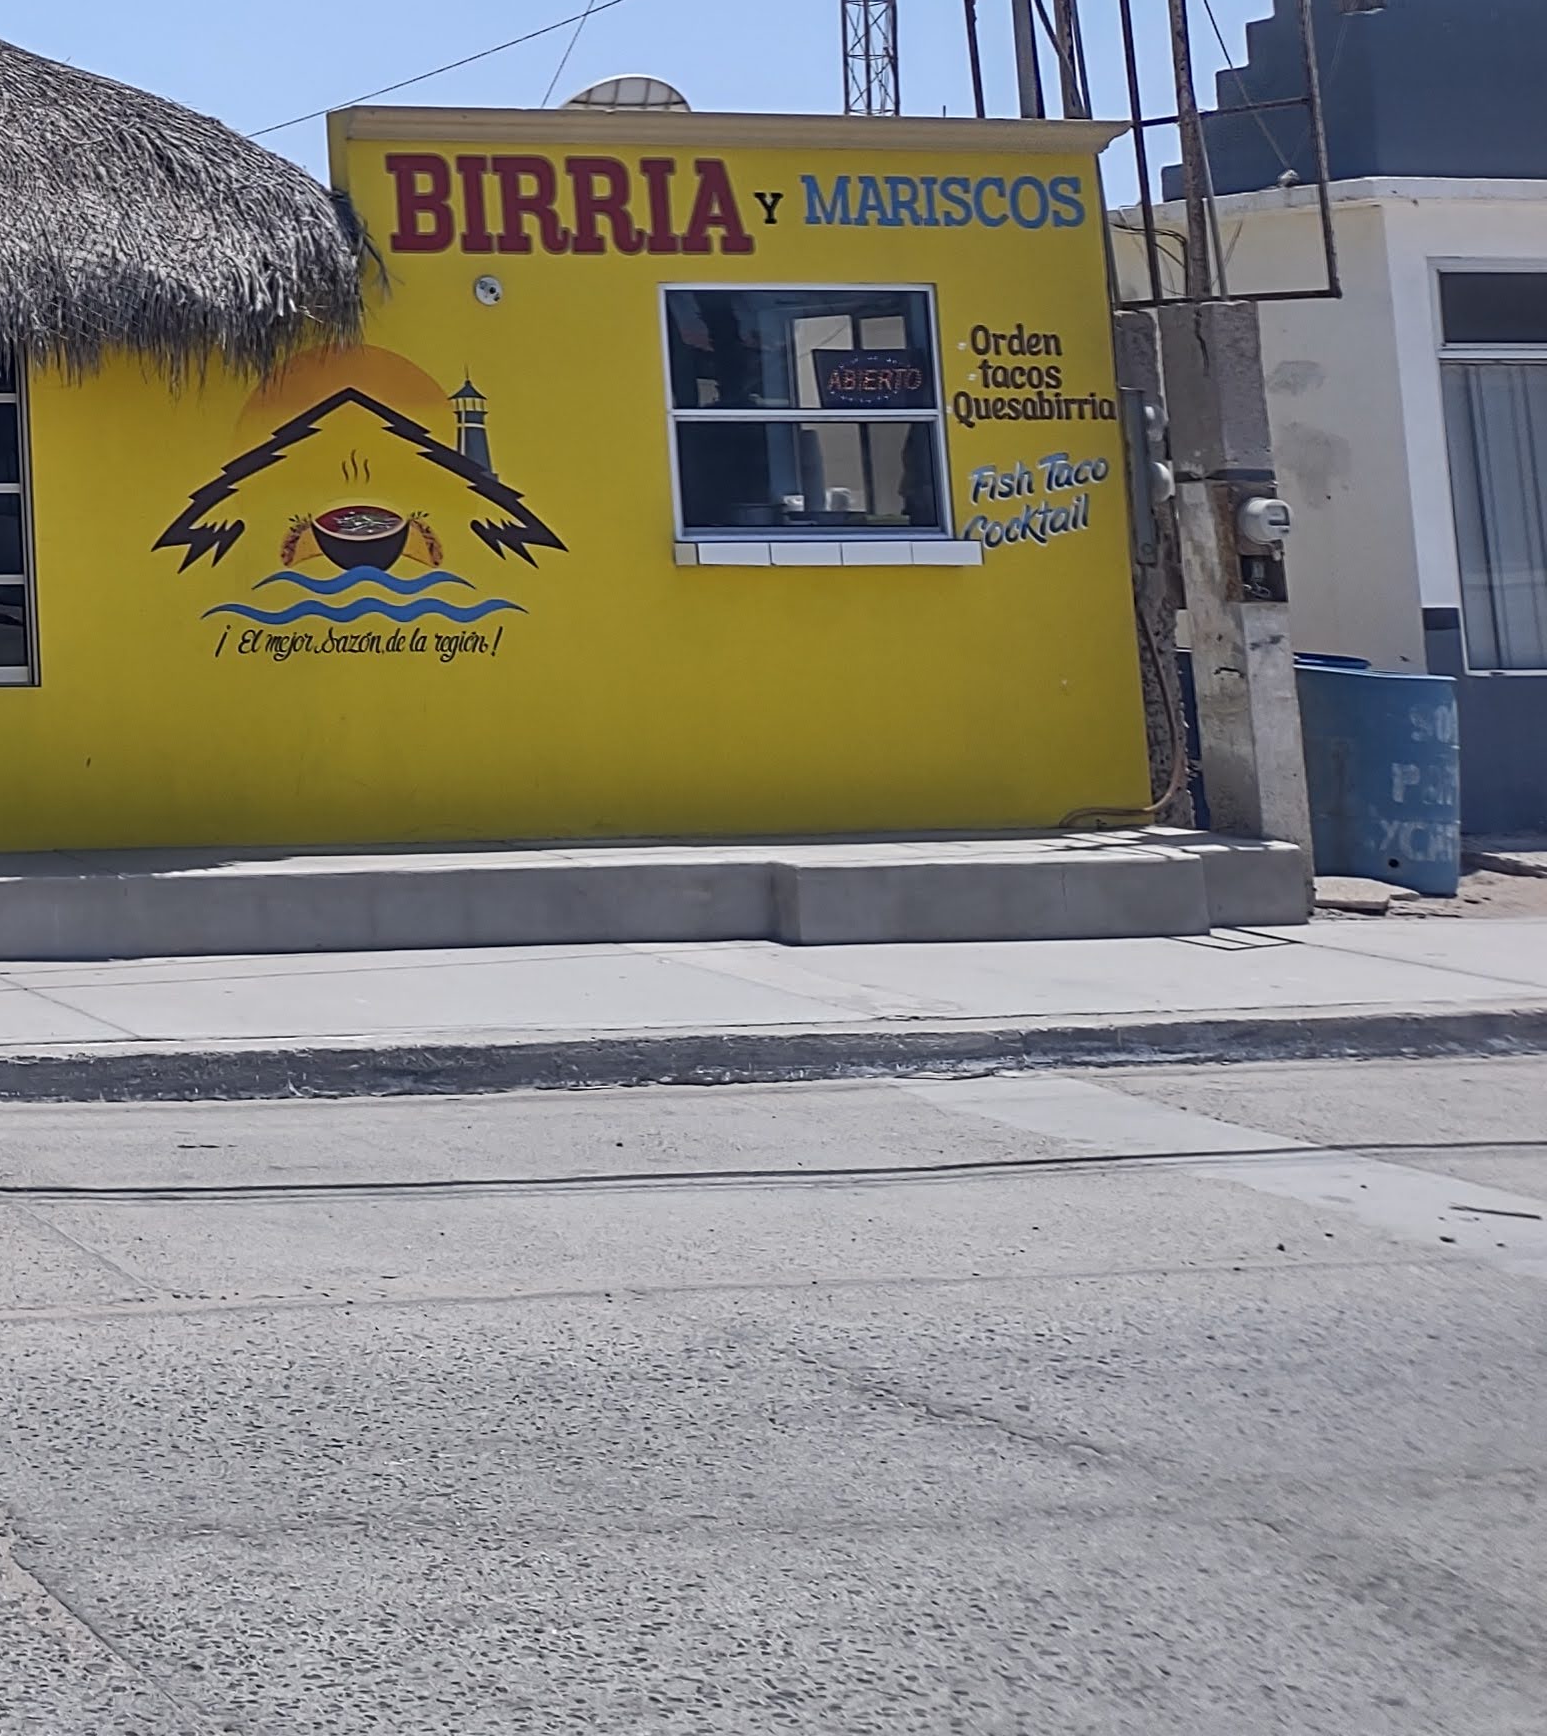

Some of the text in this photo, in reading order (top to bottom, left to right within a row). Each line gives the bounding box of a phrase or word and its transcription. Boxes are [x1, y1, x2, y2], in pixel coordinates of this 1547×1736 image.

[385, 153, 1086, 255] BIRRIA Y MARISCOS
[970, 323, 1064, 357] Orden
[827, 367, 924, 392] ABIERTO
[977, 358, 1063, 390] tacos
[952, 390, 1118, 429] Quesabirria
[969, 451, 1110, 507] Fish Taco
[385, 628, 407, 653] de
[409, 627, 428, 653] la
